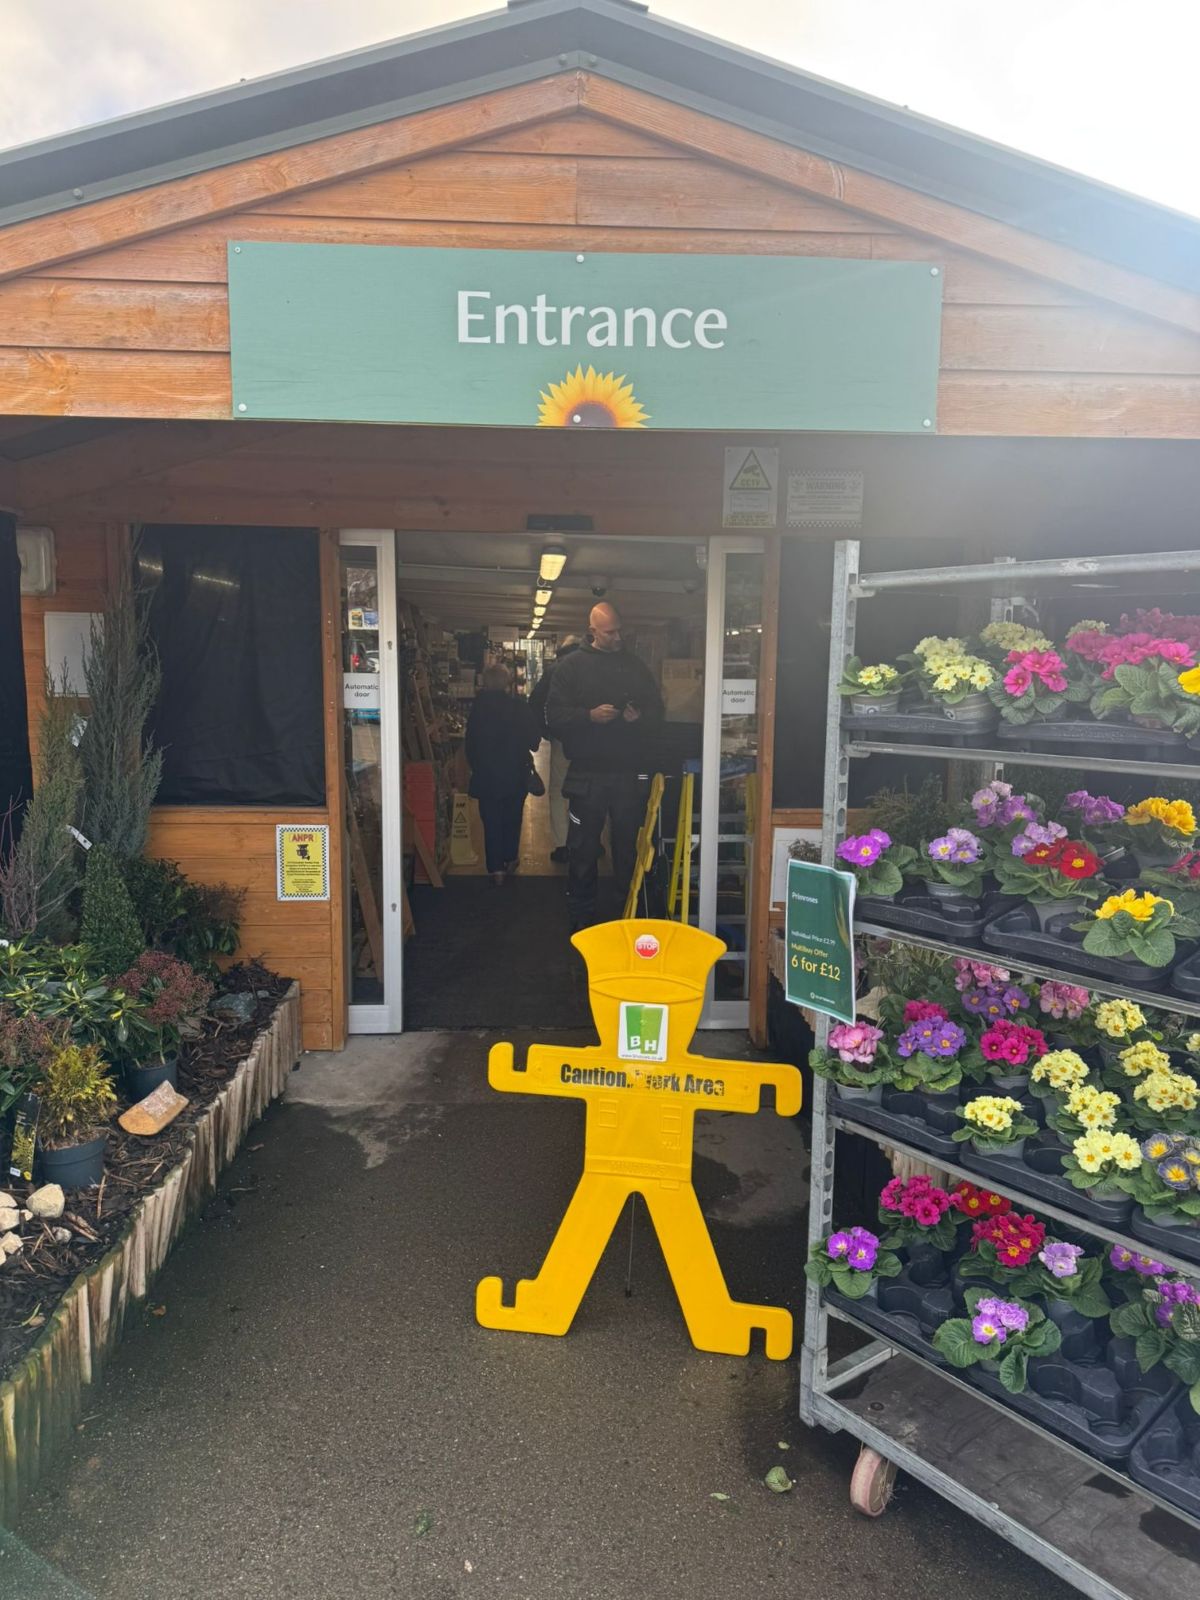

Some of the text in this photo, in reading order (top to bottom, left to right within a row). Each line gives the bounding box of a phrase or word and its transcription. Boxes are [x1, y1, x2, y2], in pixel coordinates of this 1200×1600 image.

[457, 290, 728, 349] Entrance
[722, 689, 755, 697] Automatic
[292, 833, 314, 843] ANPR
[791, 891, 818, 905] Primroses
[811, 934, 824, 943] Price
[638, 943, 658, 951] STOP
[791, 942, 829, 958] Multibuy Offer
[791, 954, 841, 981] 6 for £12
[634, 1069, 681, 1092] ork
[684, 1074, 725, 1096] Area
